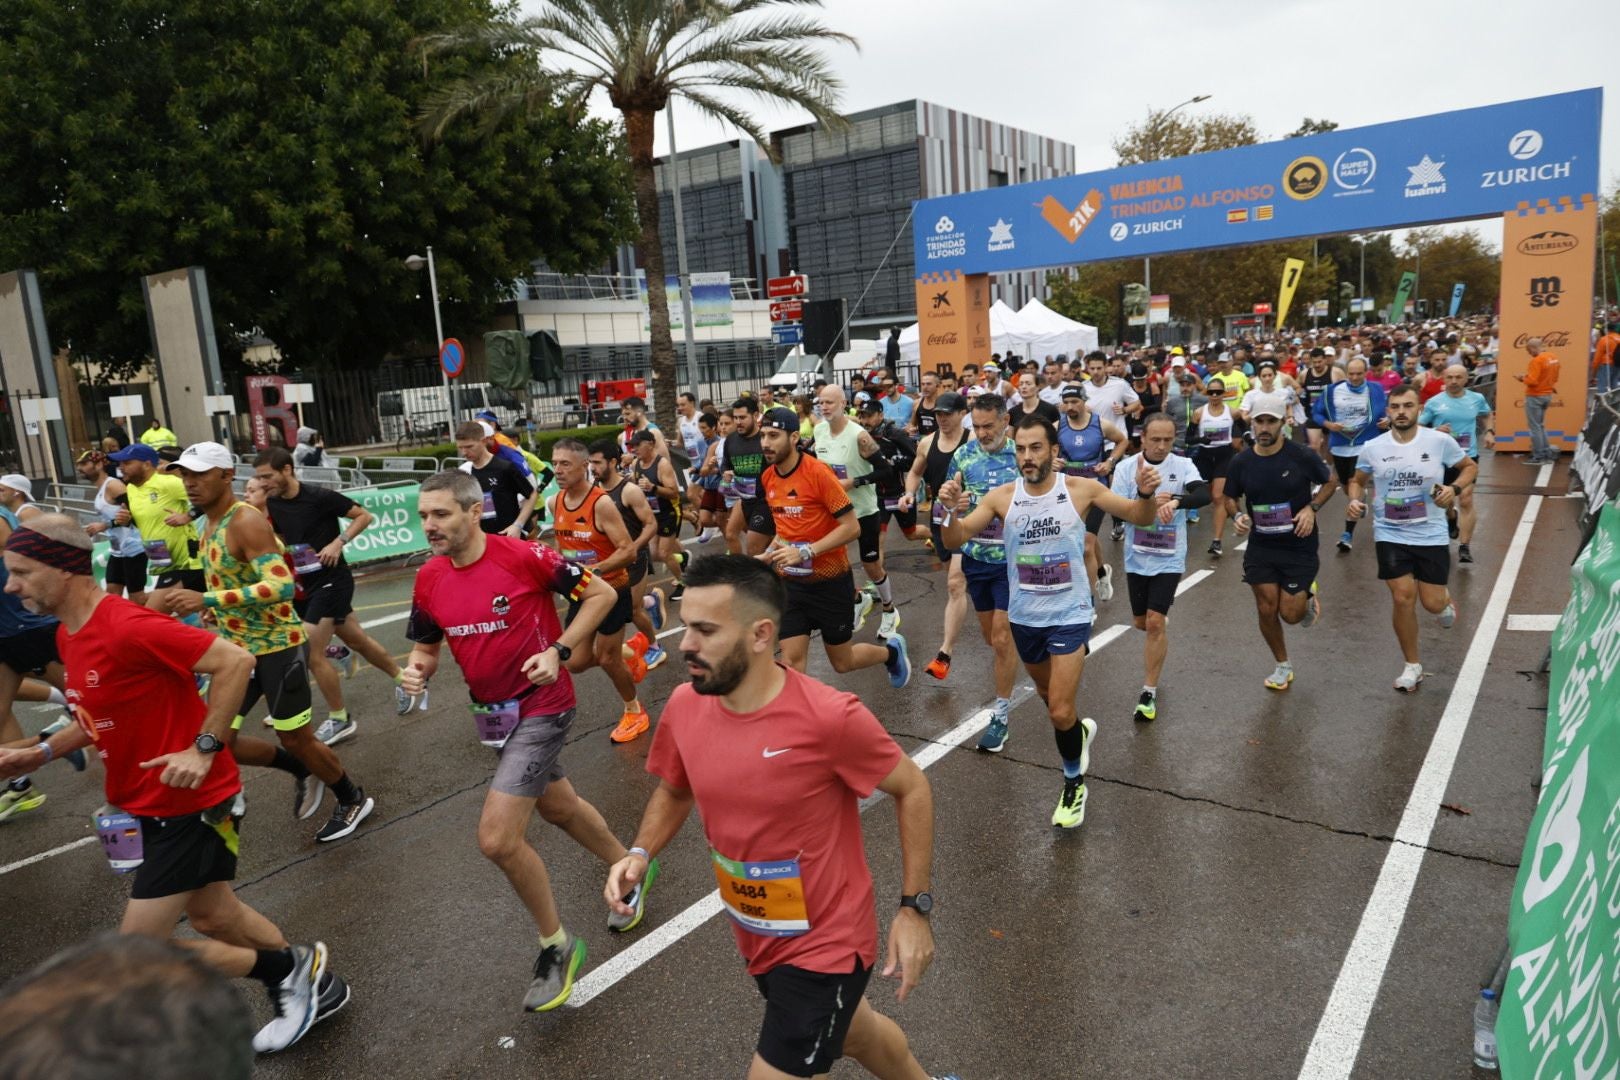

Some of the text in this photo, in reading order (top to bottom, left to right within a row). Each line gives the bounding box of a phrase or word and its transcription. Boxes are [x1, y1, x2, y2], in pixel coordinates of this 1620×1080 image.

[1341, 160, 1369, 169] SUPER
[1341, 167, 1369, 177] HALFS
[1480, 161, 1571, 189] ZURICH
[1109, 175, 1184, 201] VALENCIA
[1404, 182, 1447, 198] luanvi
[1110, 196, 1186, 219] TRINIDAD
[1190, 184, 1275, 209] ALFONSO
[1069, 199, 1096, 235] 21K
[1133, 219, 1183, 236] ZURICH
[926, 238, 966, 251] TRINIDAD
[987, 240, 1015, 252] luanvi
[927, 247, 966, 259] ALFONSO
[1286, 267, 1299, 288] 1
[1400, 278, 1412, 292] 2
[1453, 287, 1462, 298] 3
[927, 331, 958, 346] Coca-Cola
[255, 414, 266, 446] ACCESO
[1026, 525, 1061, 539] DESTINO
[475, 618, 509, 634] TRAIL
[762, 865, 792, 875] ZURICH
[731, 880, 767, 899] 6484
[739, 902, 767, 918] ERIC
